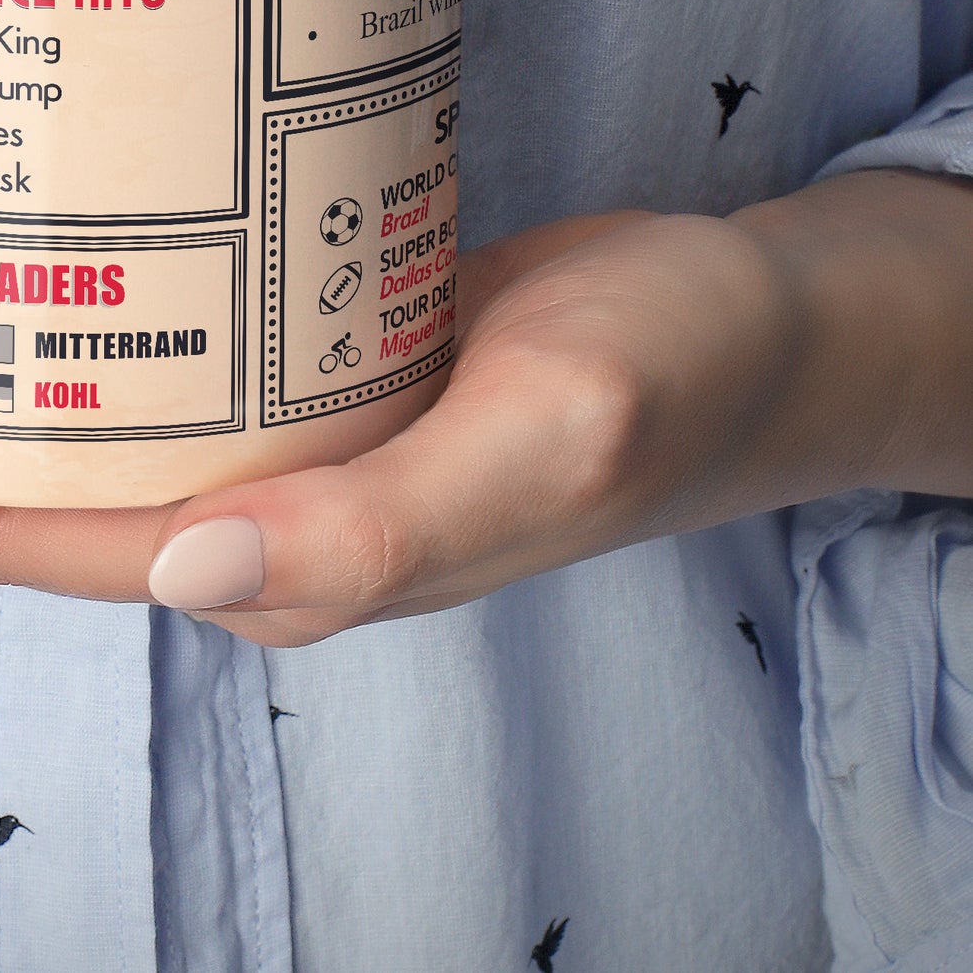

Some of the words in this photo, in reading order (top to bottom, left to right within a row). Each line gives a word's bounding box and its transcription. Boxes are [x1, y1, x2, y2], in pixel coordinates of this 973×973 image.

[380, 162, 445, 210] WORLD
[380, 194, 430, 238] Brazil
[379, 229, 436, 273] SUPER
[379, 262, 433, 300] Dallas
[379, 293, 428, 333] TOUR
[432, 278, 450, 309] DE
[34, 328, 208, 360] MITTERRAND
[379, 310, 437, 360] Miguel
[33, 381, 102, 409] KOHL
